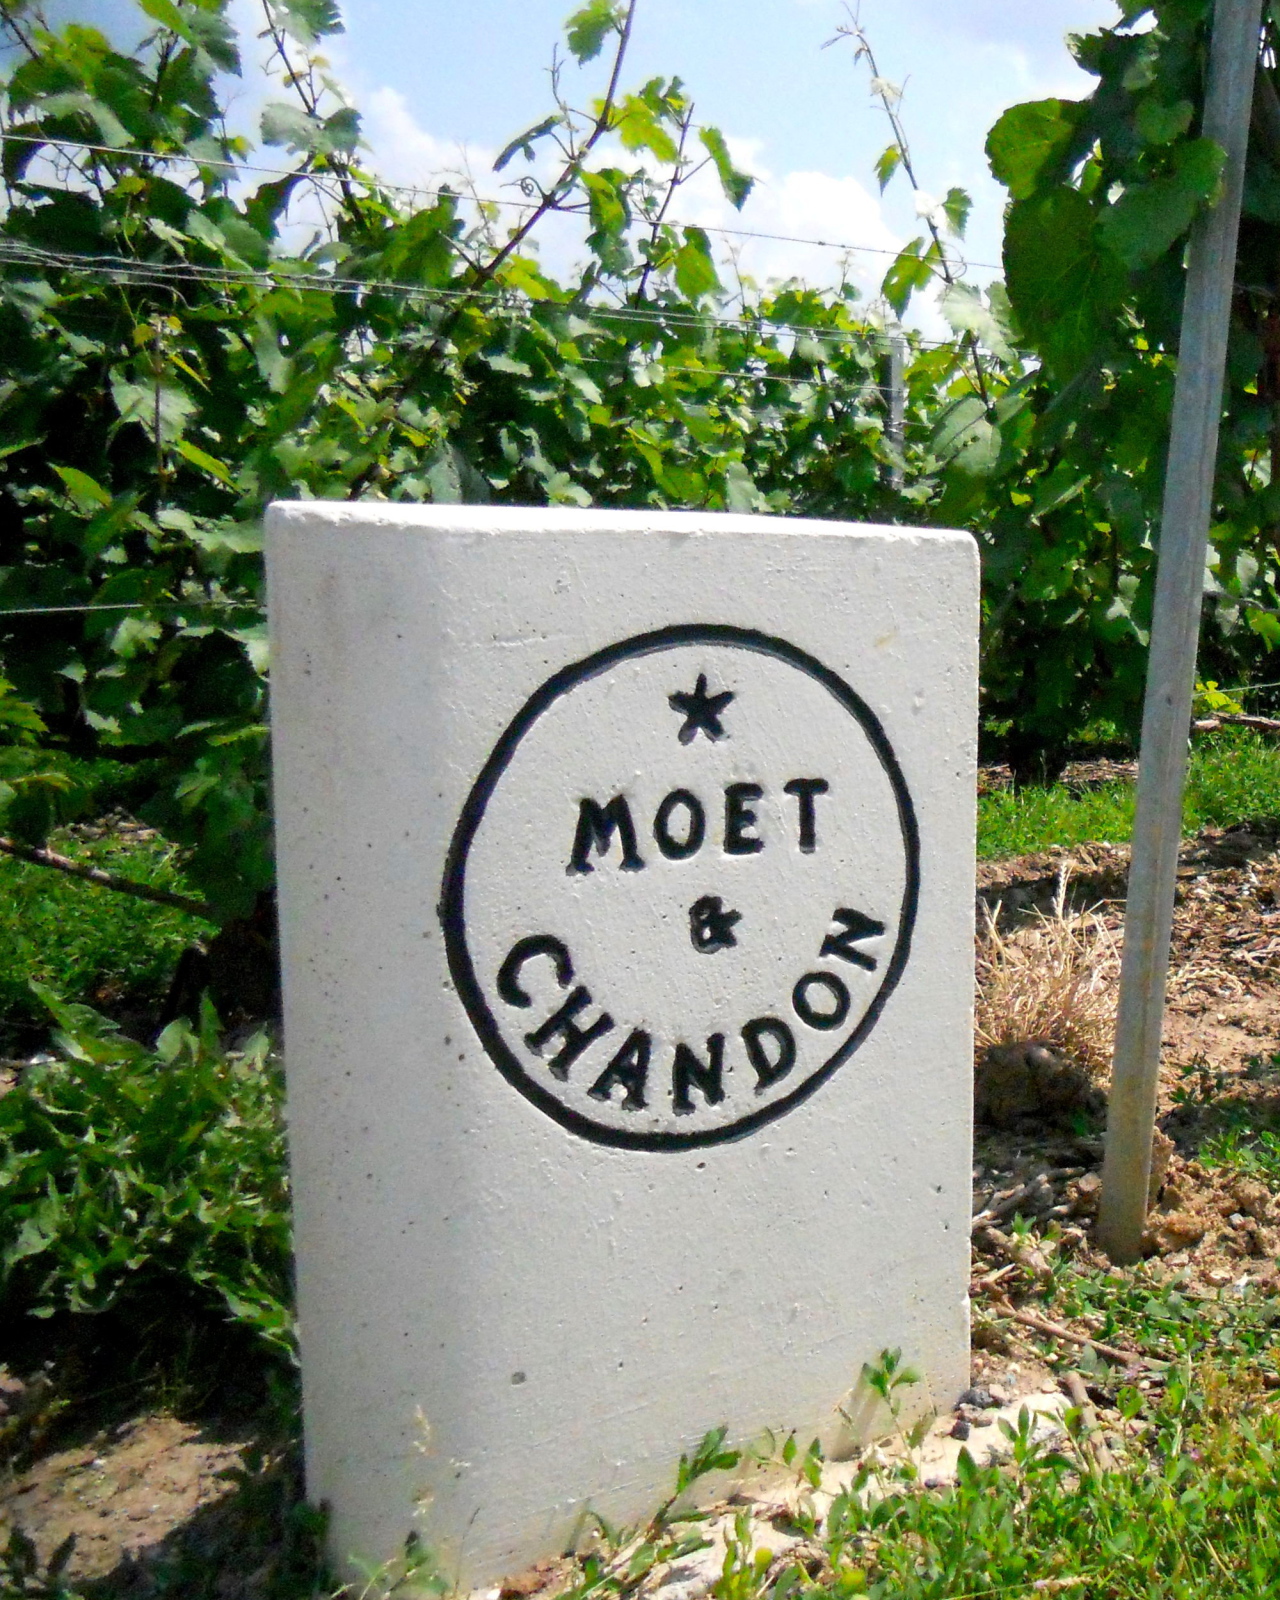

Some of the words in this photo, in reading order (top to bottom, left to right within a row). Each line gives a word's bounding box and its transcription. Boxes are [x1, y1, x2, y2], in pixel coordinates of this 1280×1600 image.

[566, 778, 829, 875] MOET
[689, 896, 743, 954] &
[496, 908, 886, 1115] CHANDON
